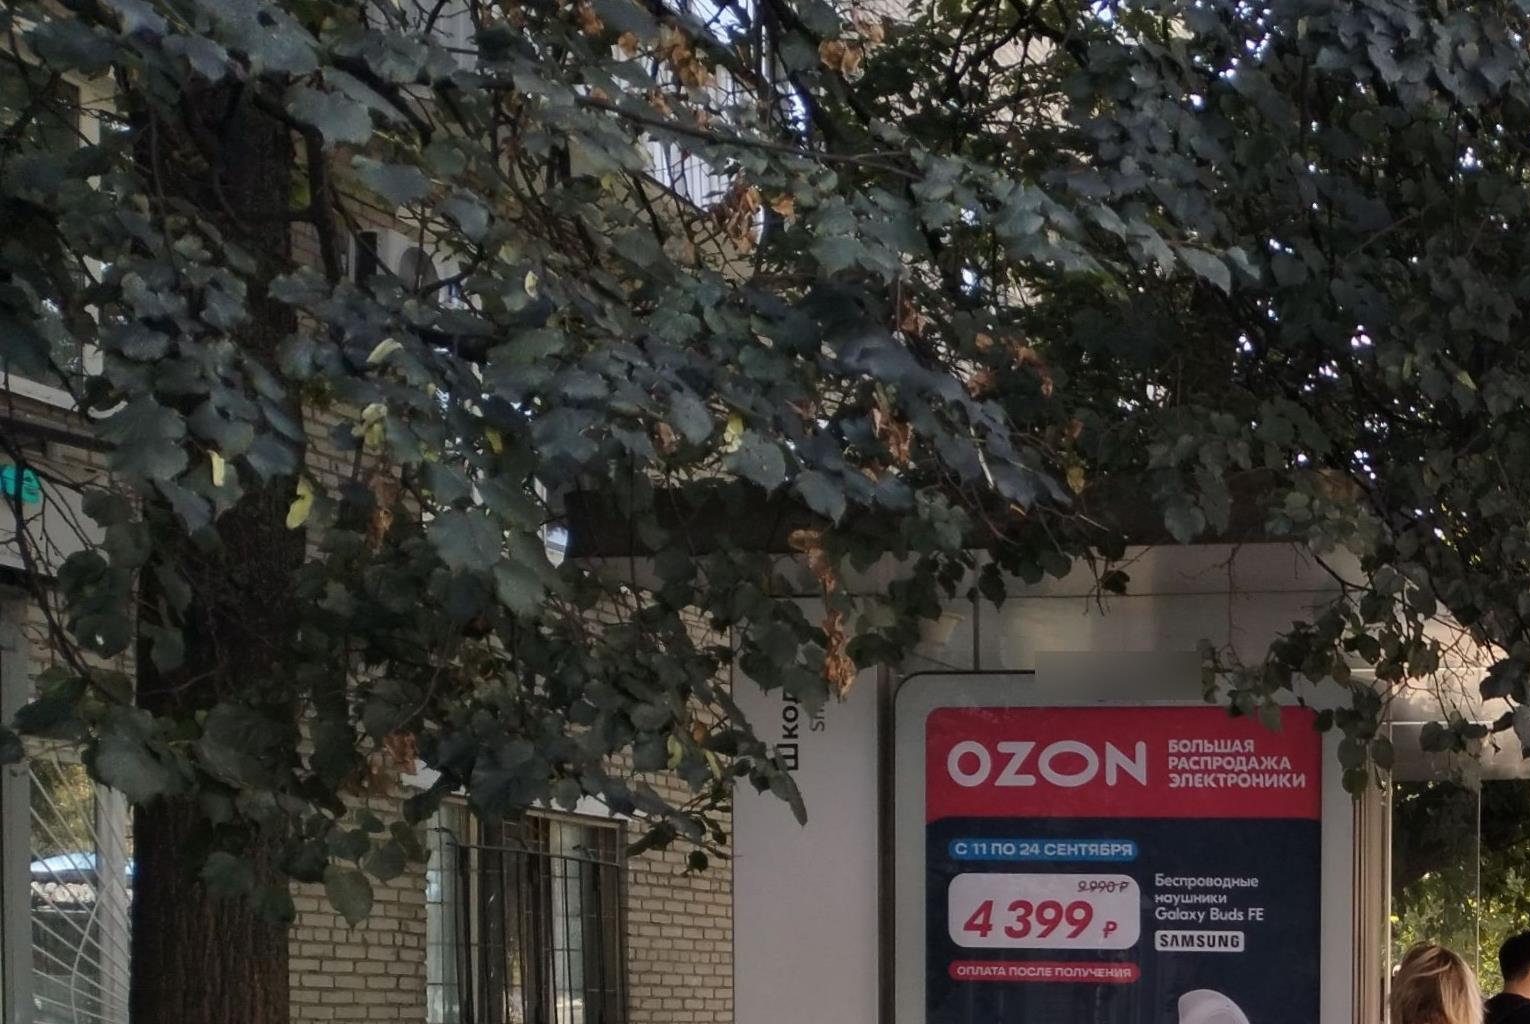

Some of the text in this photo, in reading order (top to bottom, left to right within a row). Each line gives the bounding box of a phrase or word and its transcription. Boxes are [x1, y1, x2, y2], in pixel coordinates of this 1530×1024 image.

[1168, 739, 1255, 754] БОЛЬШАЯ
[947, 740, 1148, 787] OZON
[1168, 756, 1292, 772] РАСПРОДАЖА
[1168, 772, 1306, 789] ЭЛЕКТРОНИКИ
[955, 843, 1133, 857] С 11 ПО 24 СЕНТЯБРЯ
[1155, 873, 1259, 890] Беспроводные
[1155, 894, 1228, 906] наушники
[1155, 907, 1264, 924] Galaxy Buds FE
[1160, 934, 1240, 949] SAMSUNG
[957, 966, 1132, 978] ОПЛАТА ПОСЛЕ ПОЛУЧЕНИЯ
